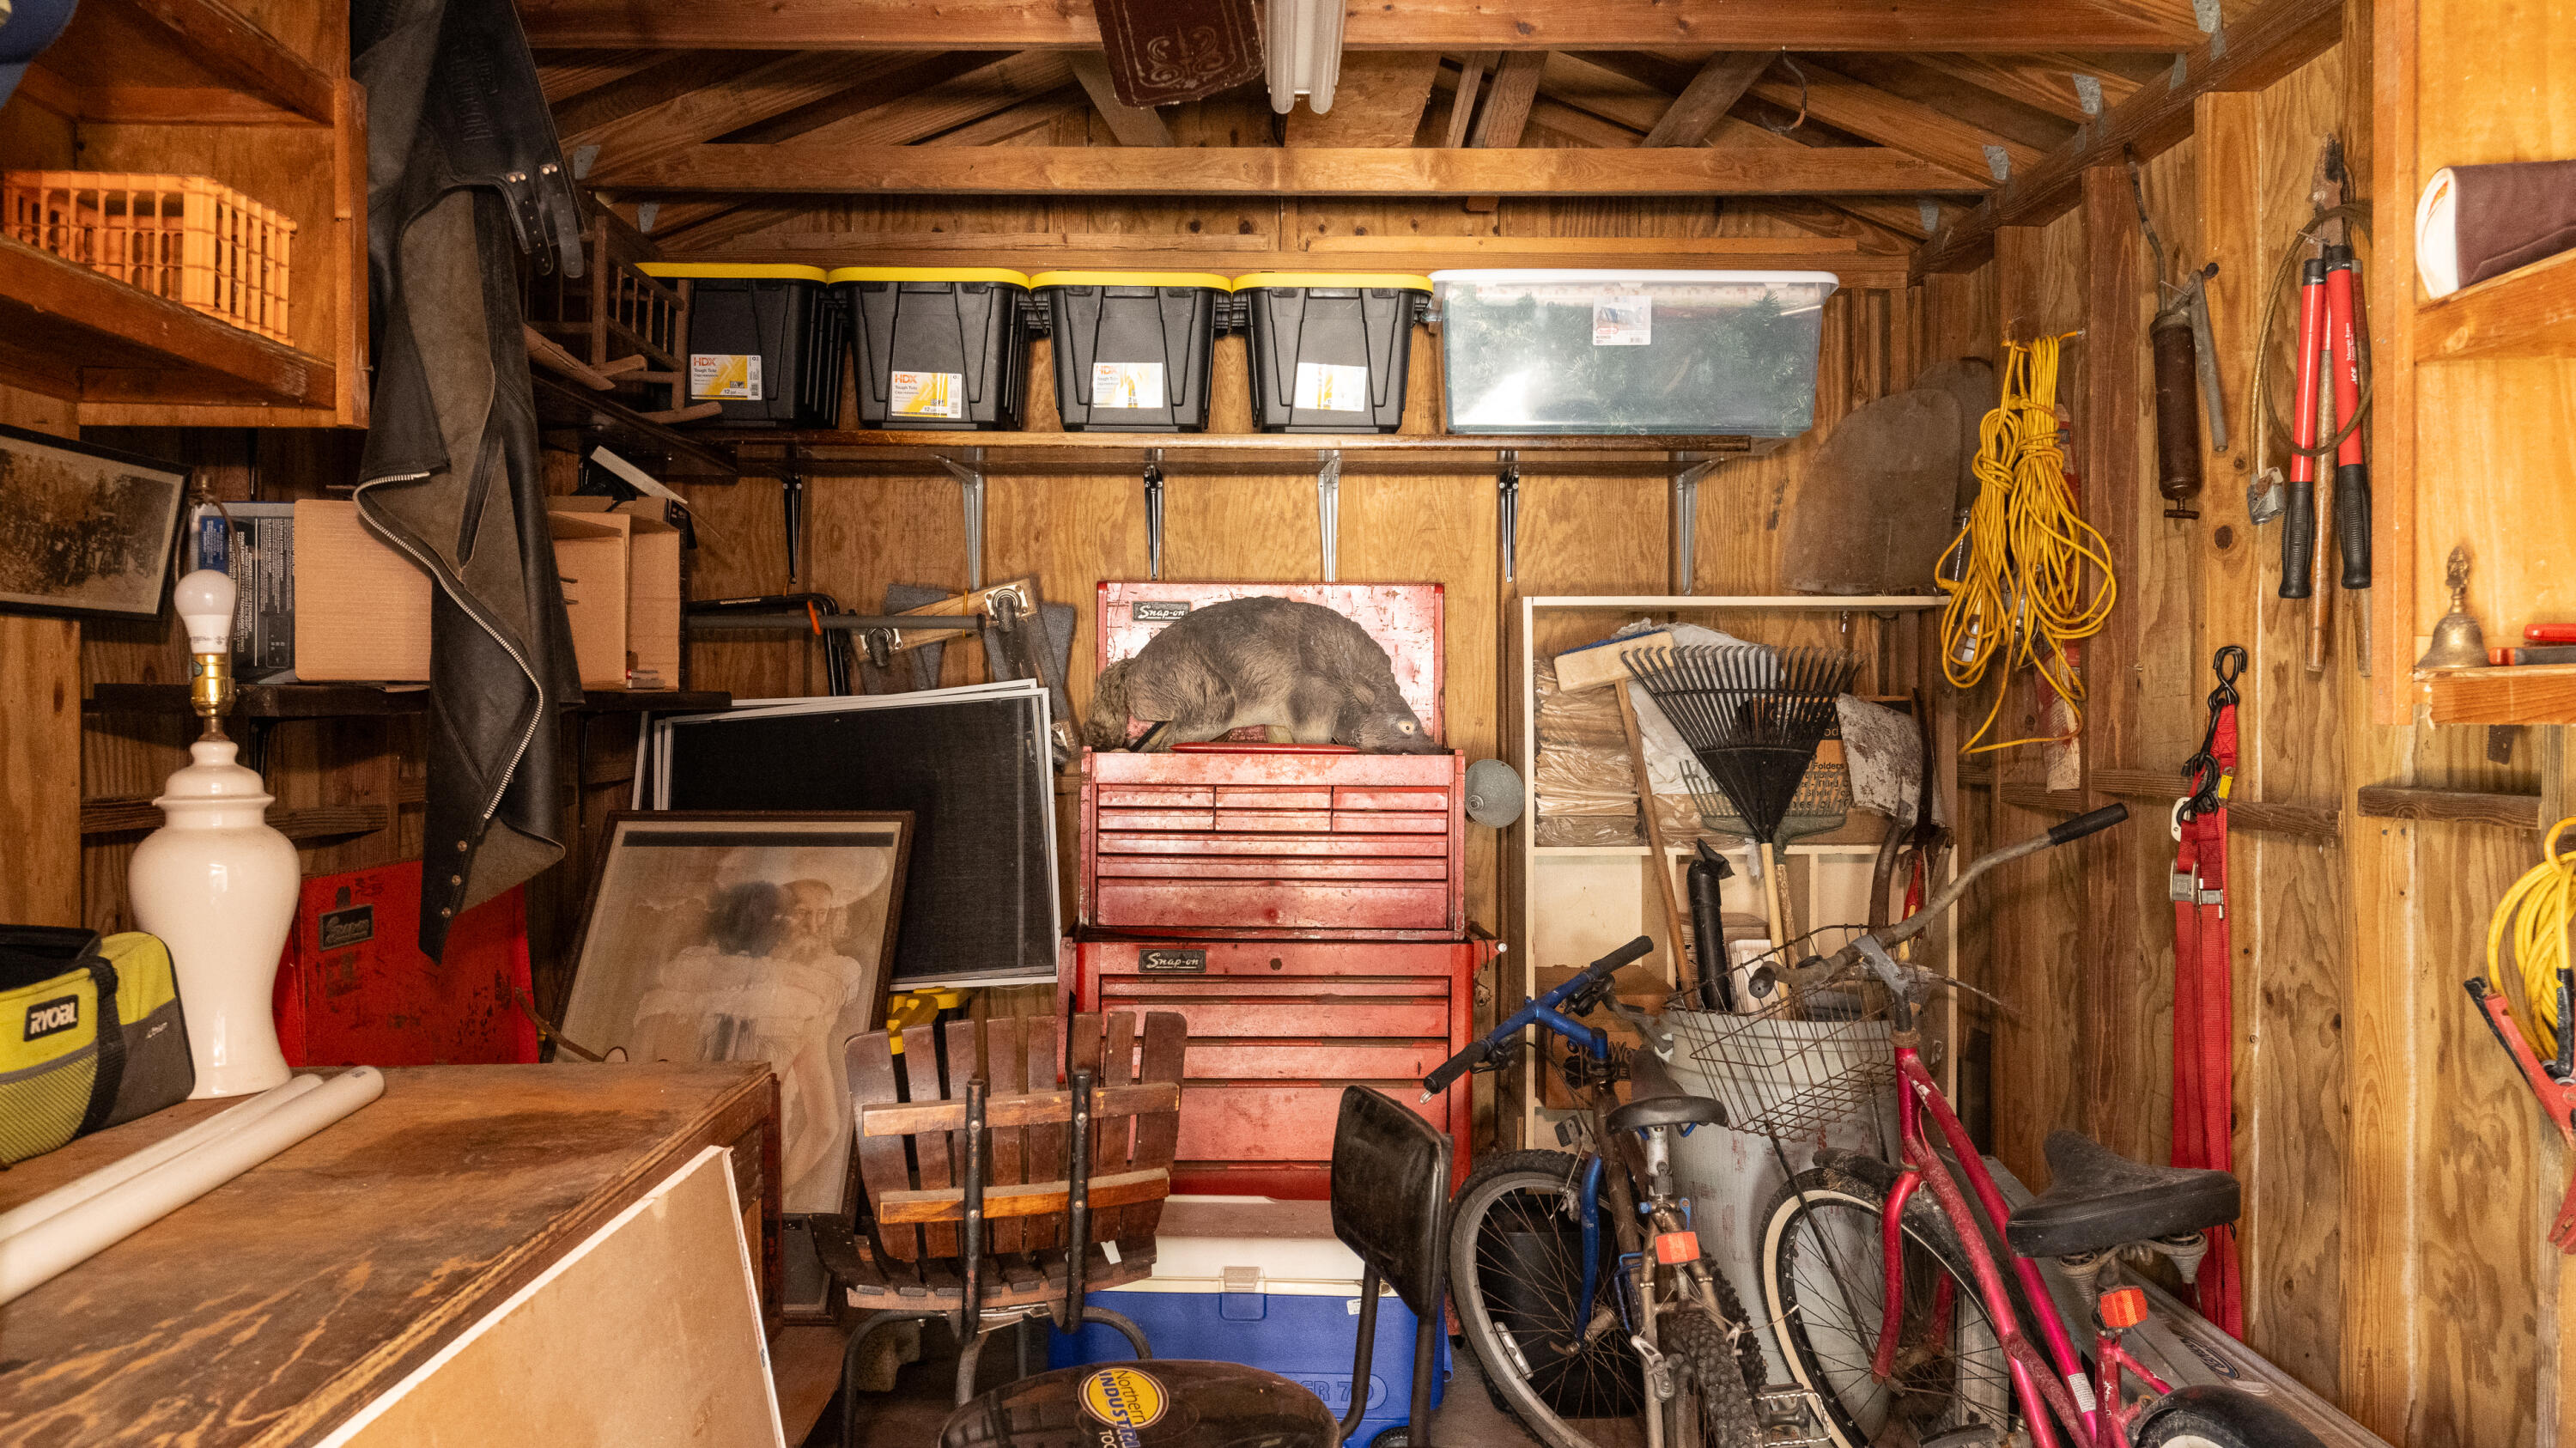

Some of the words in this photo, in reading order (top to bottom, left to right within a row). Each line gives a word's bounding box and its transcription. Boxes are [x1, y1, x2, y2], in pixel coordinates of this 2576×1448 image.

[694, 357, 715, 366] HDX
[895, 374, 917, 384] HDX
[1138, 605, 1185, 619] Snap-on
[1146, 952, 1199, 969] Snap-on
[30, 1002, 77, 1034] RYOBI
[1114, 1370, 1146, 1424] Northern
[1099, 1372, 1140, 1448] INDUSTRI
